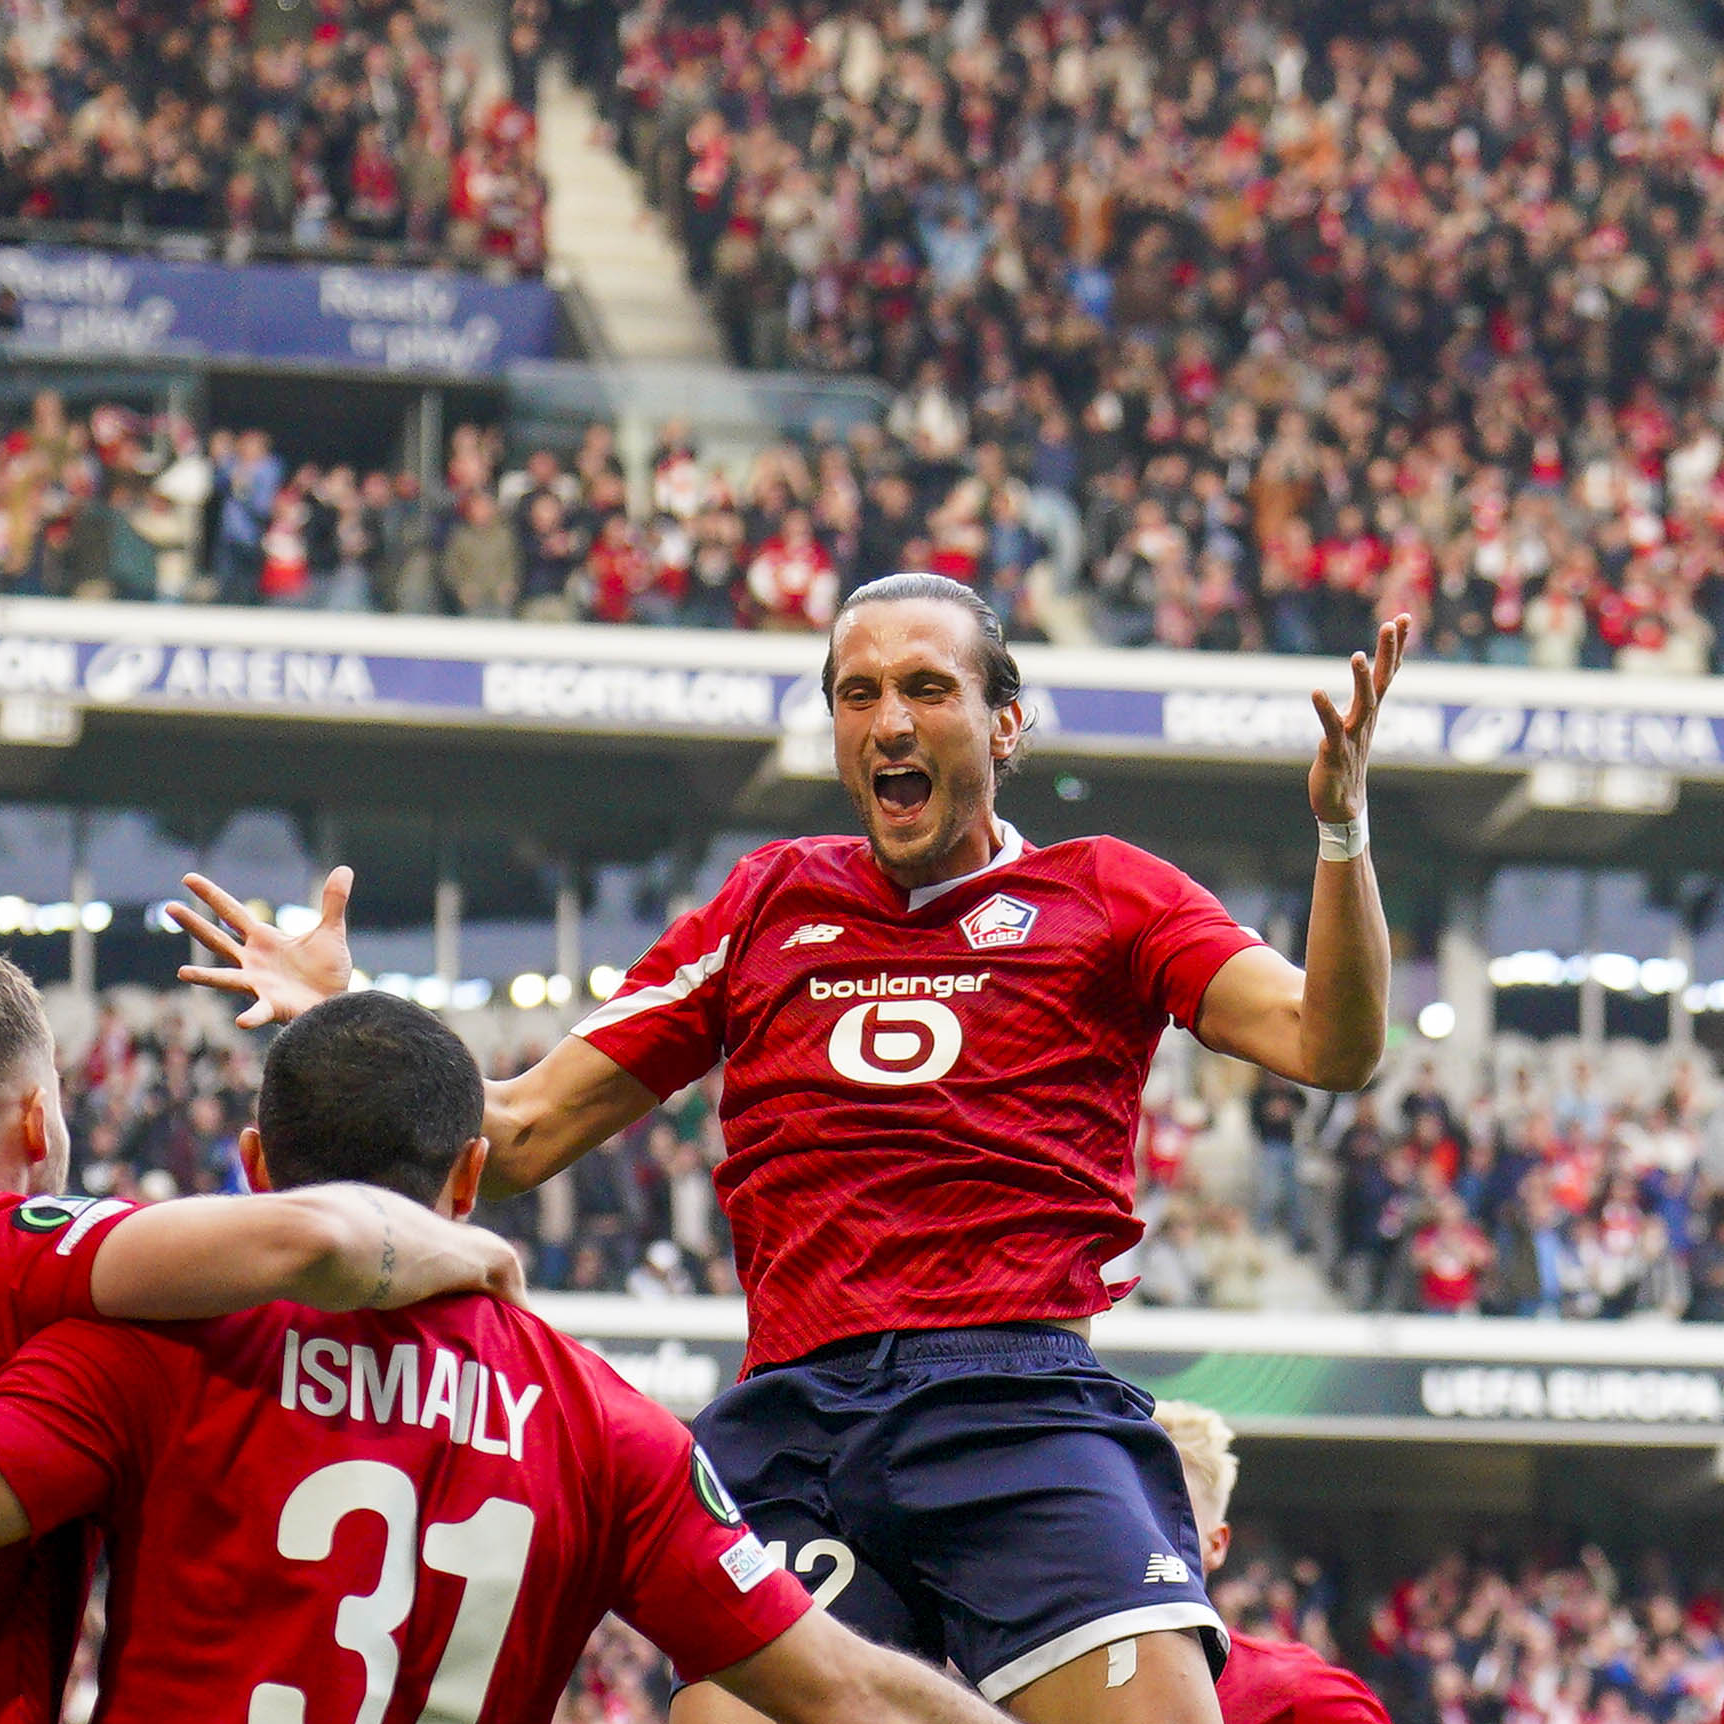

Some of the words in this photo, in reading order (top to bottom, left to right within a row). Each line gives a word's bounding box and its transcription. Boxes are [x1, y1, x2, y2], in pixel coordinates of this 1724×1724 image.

[162, 647, 376, 702] ARENA
[482, 662, 776, 722] DECATHLON
[1518, 706, 1720, 762] ARENA
[978, 931, 1019, 944] LOSC
[809, 972, 990, 1000] boulanger
[280, 1328, 543, 1462] ISMAILY
[1421, 1366, 1547, 1417] UEFA
[1549, 1368, 1720, 1423] EUROPA
